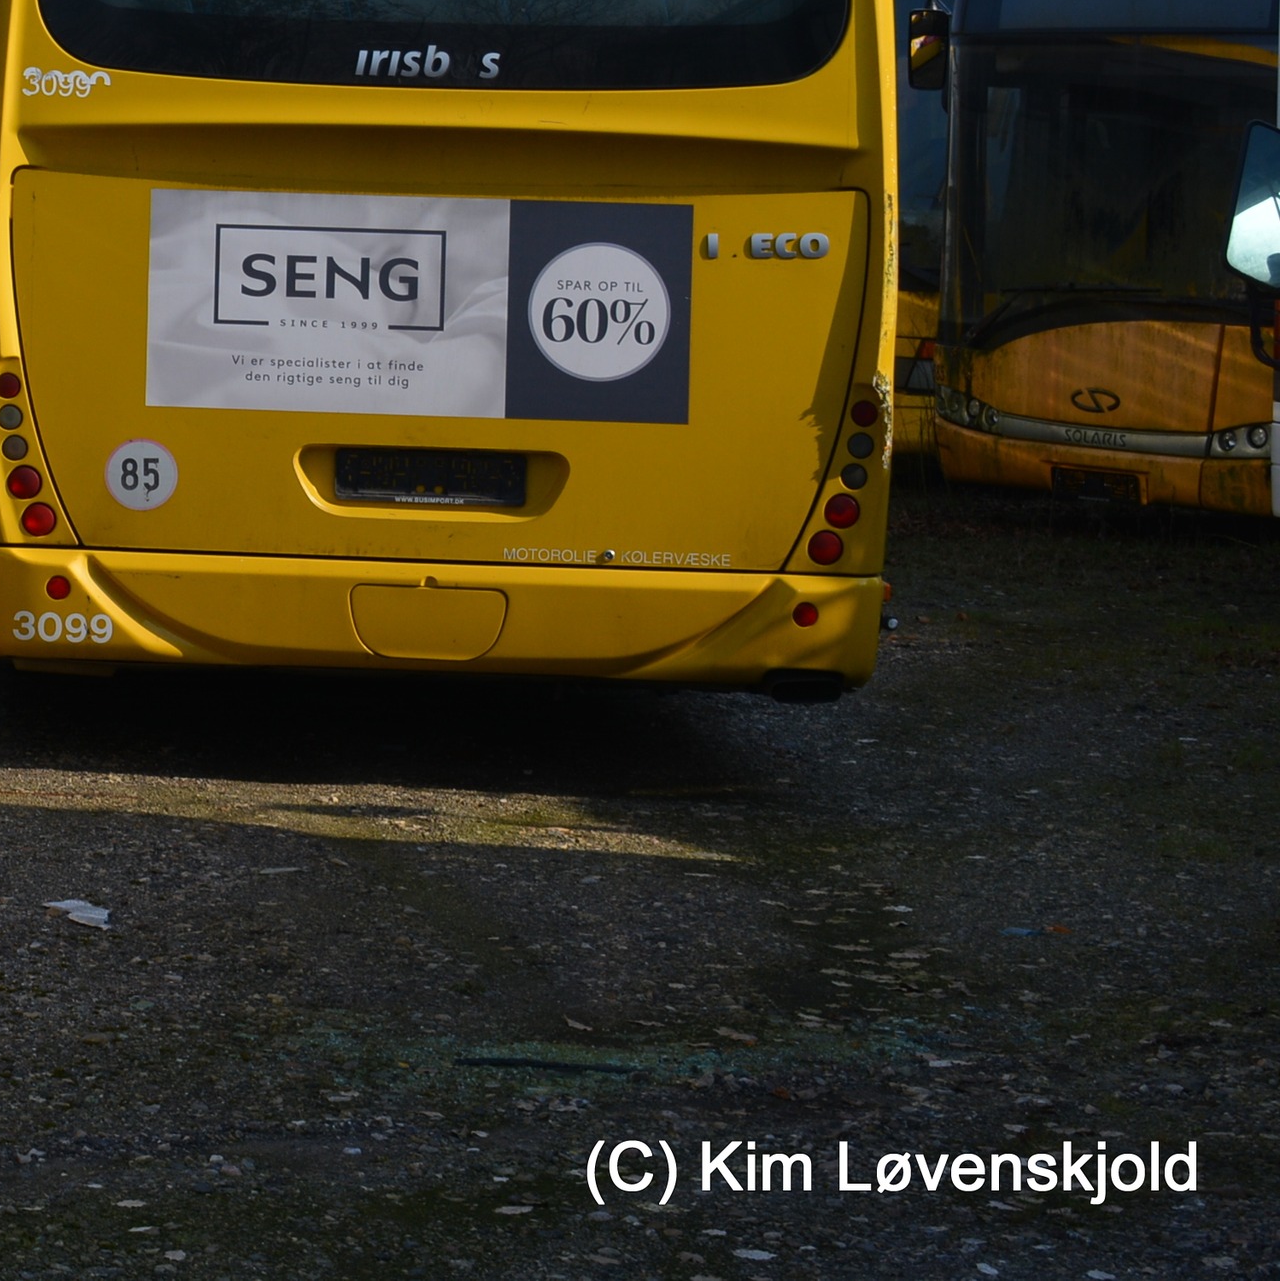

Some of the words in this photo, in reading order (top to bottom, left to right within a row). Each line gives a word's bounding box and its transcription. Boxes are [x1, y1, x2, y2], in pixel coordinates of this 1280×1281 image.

[241, 253, 420, 302] SENG
[557, 279, 592, 291] SPAR
[598, 281, 618, 292] OP
[624, 282, 644, 293] TIL
[279, 319, 329, 329] SINCE
[341, 321, 379, 330] 1999
[542, 297, 656, 346] 60%
[231, 354, 245, 366] Vi
[251, 357, 264, 366] er
[270, 357, 352, 370] specialister
[367, 361, 382, 370] at
[388, 360, 425, 372] finde
[245, 371, 271, 382] den
[276, 372, 324, 386] rigtige
[329, 376, 362, 388] seng
[368, 375, 382, 386] til
[387, 376, 410, 390] dig
[1064, 428, 1127, 448] SOLARIS
[120, 458, 160, 492] 85
[394, 495, 465, 505] WWW.BUSIMPORT.DK
[503, 547, 597, 563] MOTOROLIE
[620, 550, 731, 567] KØLERVÆSKE
[12, 610, 113, 644] 3099
